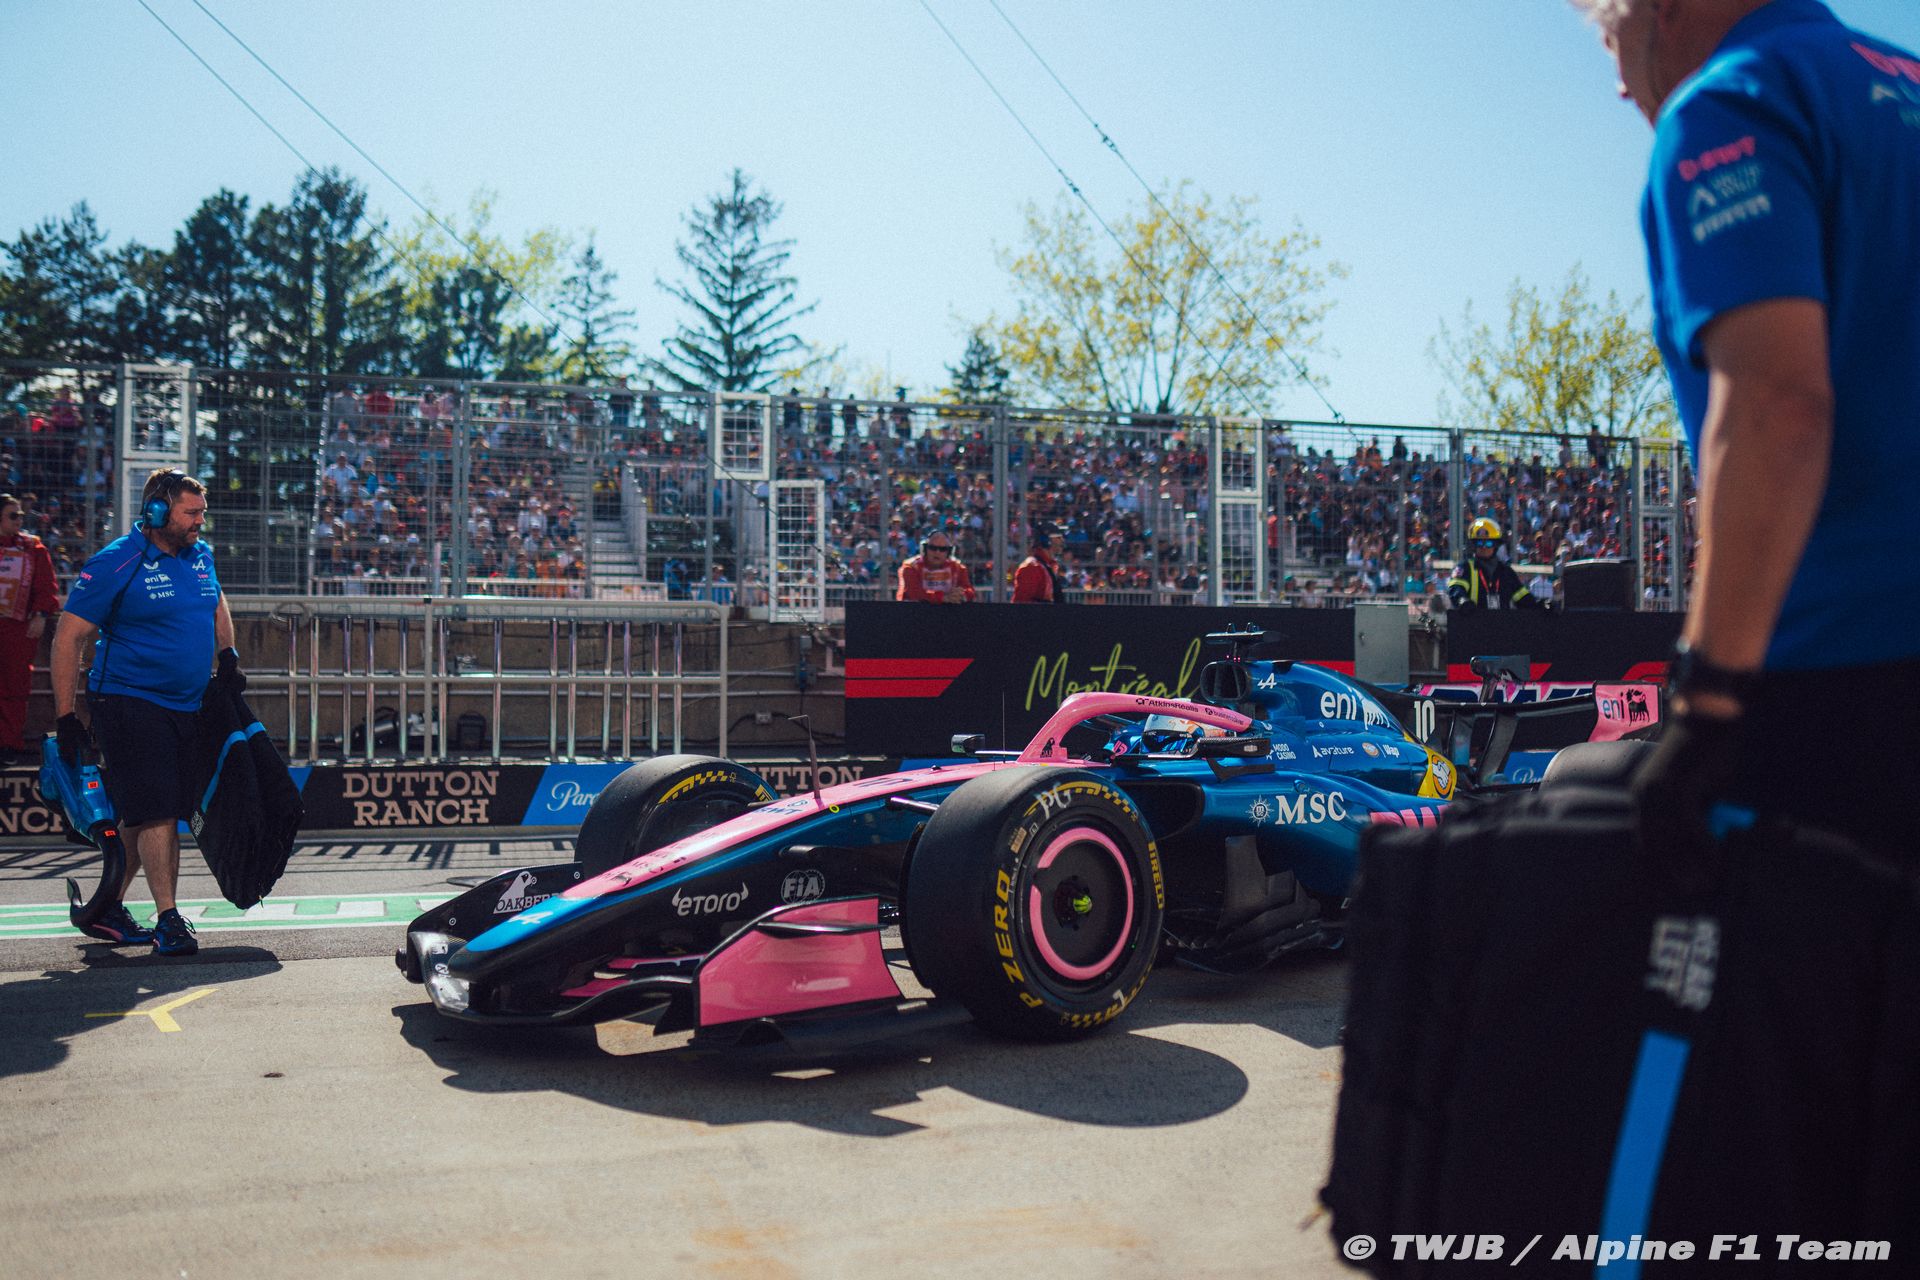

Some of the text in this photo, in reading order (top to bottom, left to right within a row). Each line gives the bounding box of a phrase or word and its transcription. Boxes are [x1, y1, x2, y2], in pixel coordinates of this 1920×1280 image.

[1025, 637, 1200, 712] Montréal
[1320, 688, 1356, 720] eni
[1602, 691, 1625, 720] eni
[1414, 700, 1435, 743] 10
[342, 770, 499, 798] DUTTON
[353, 799, 490, 826] RANCH
[1274, 791, 1347, 825] MSC
[1147, 841, 1166, 911] PIRELLI
[994, 869, 1025, 983] ZERO
